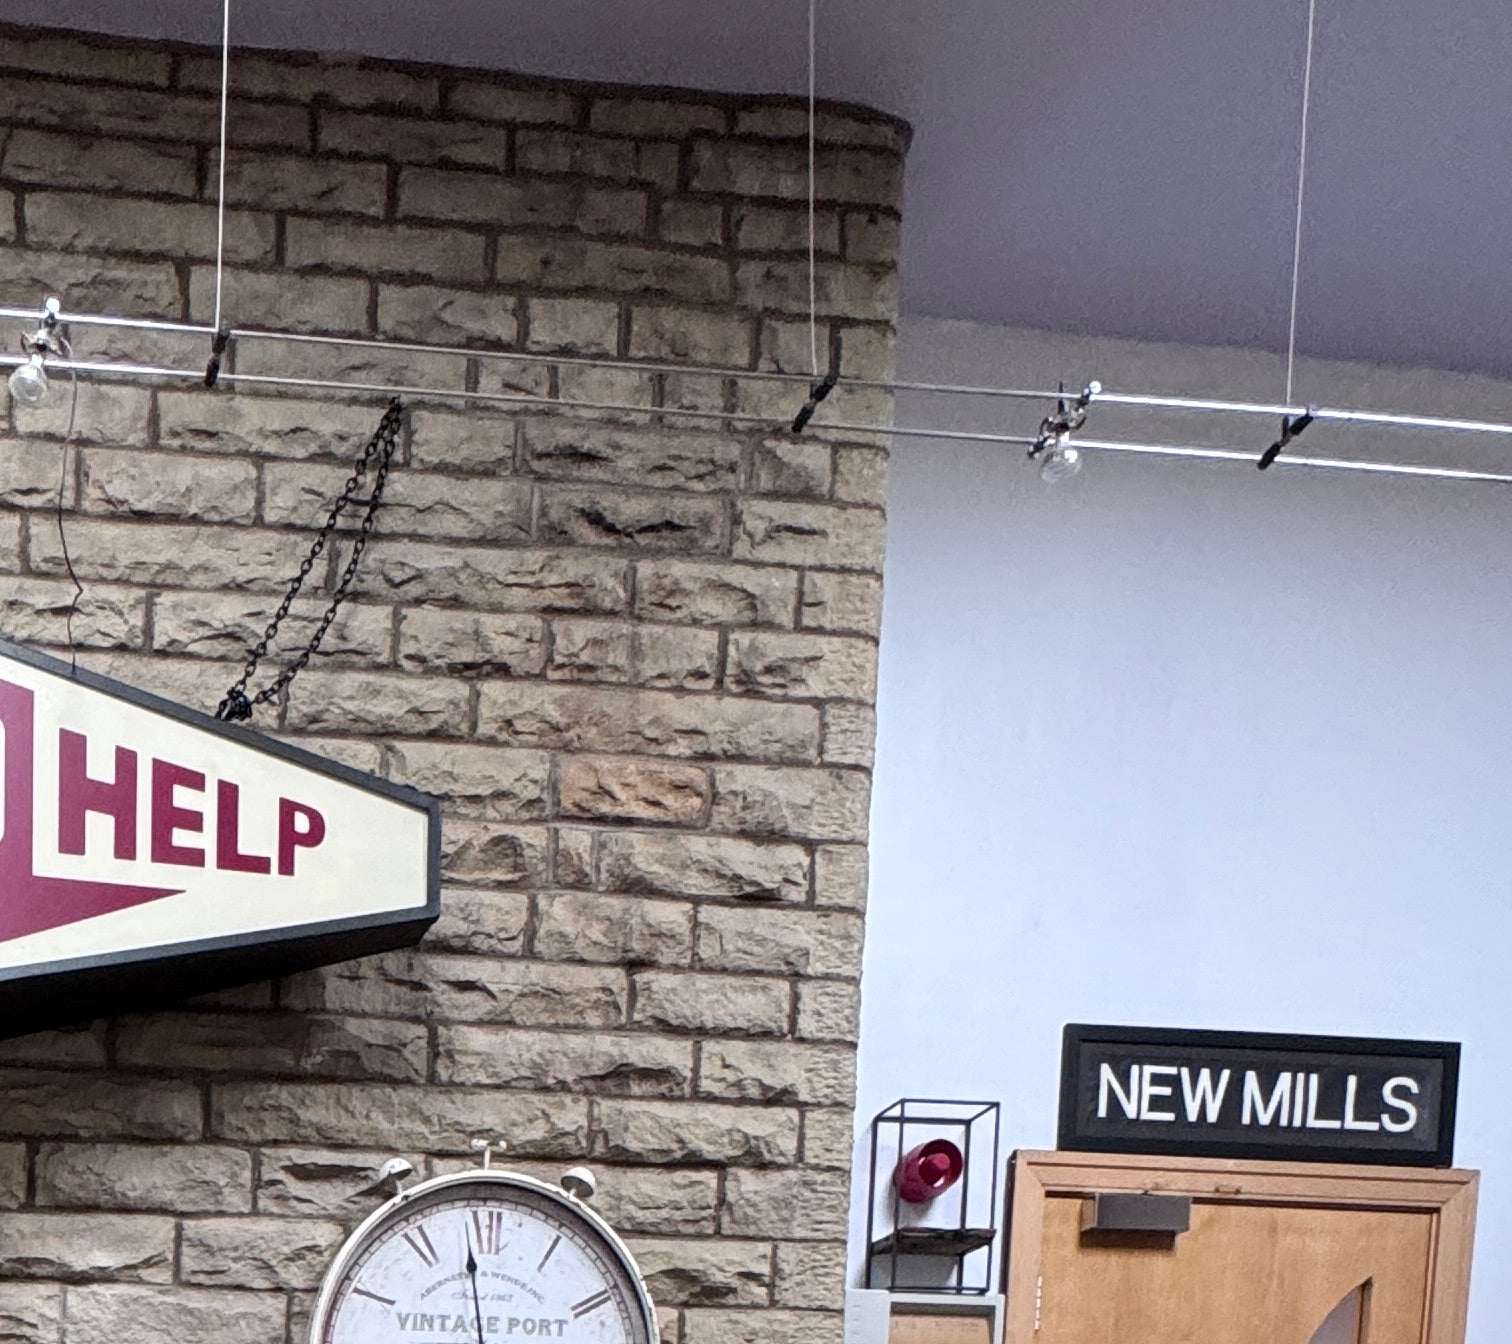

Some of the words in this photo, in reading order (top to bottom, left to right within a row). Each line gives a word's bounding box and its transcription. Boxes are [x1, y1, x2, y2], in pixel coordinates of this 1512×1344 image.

[58, 727, 327, 877] HELP
[1096, 1063, 1231, 1125] NEW
[1241, 1069, 1421, 1133] MILLS
[397, 1312, 500, 1334] VINTAGE
[506, 1317, 569, 1337] PORT
